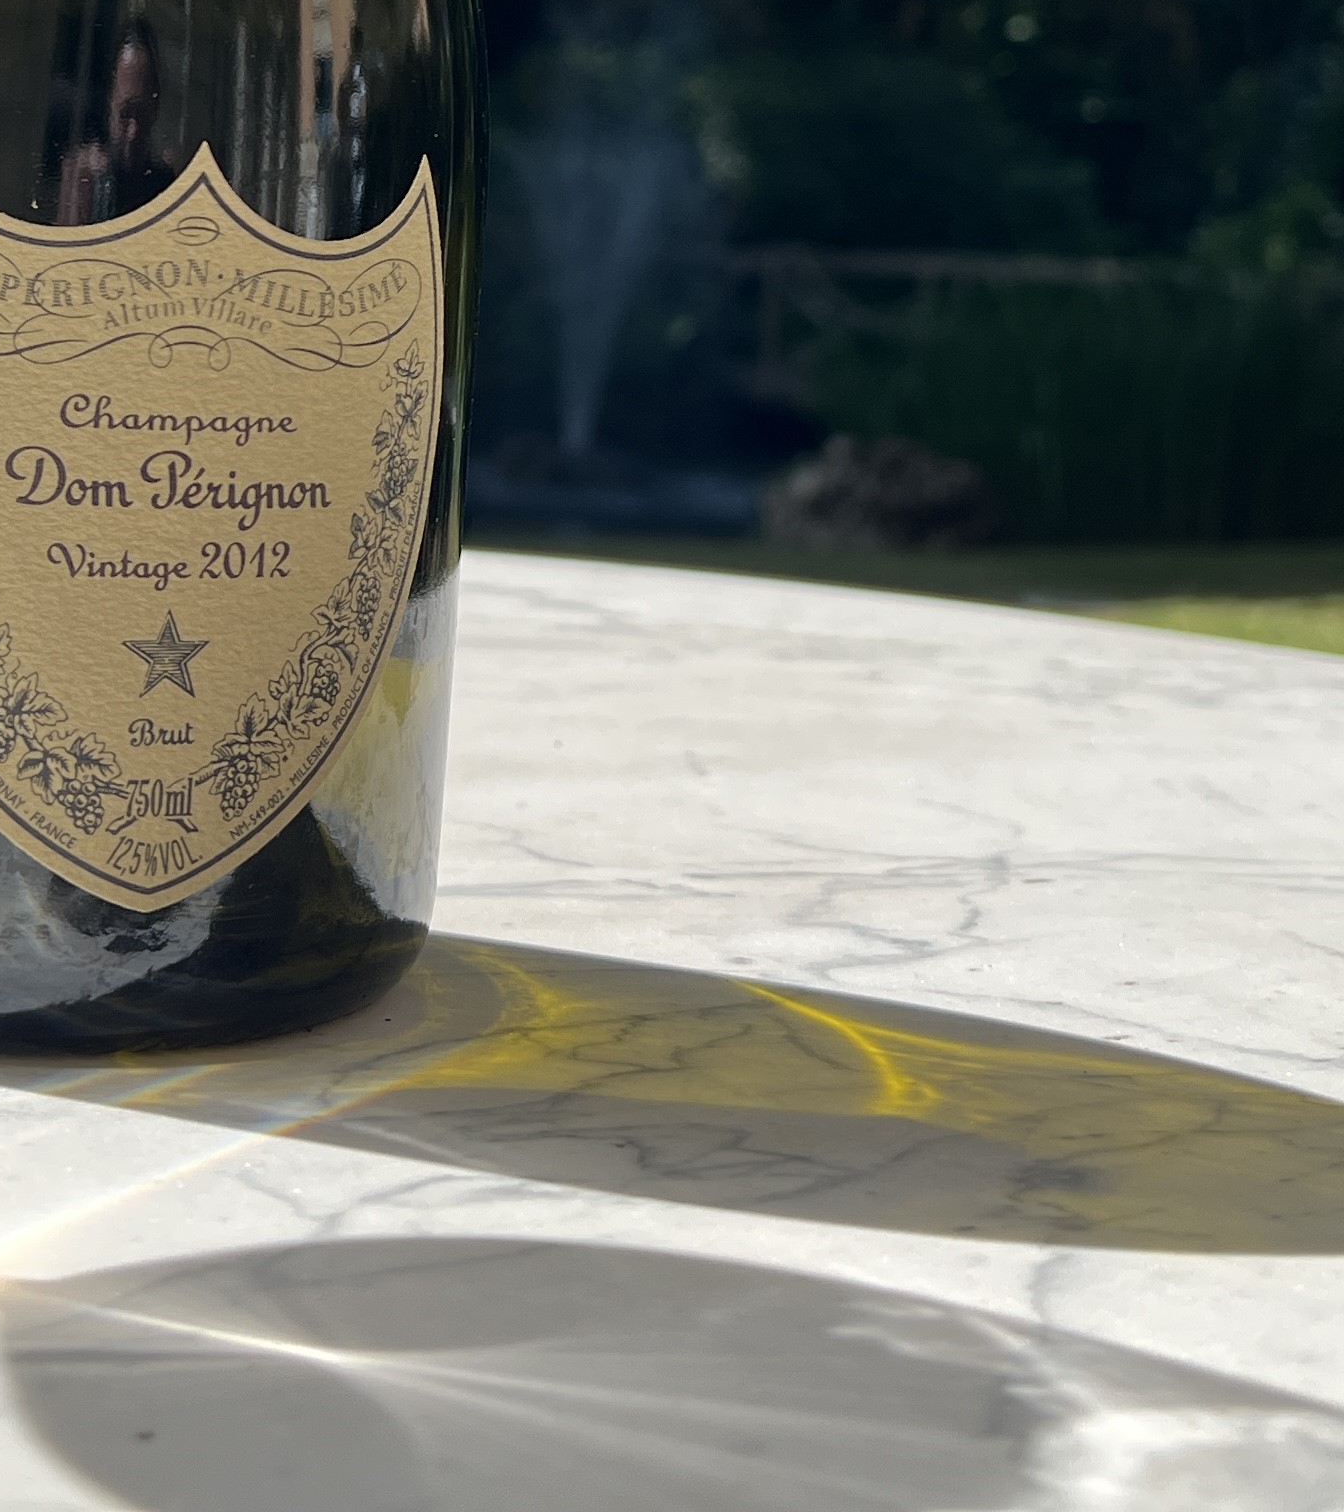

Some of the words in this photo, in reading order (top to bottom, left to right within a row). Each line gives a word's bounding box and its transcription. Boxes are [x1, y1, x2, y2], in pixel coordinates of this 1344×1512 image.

[103, 297, 186, 331] Altum
[191, 296, 273, 335] Villare
[59, 393, 298, 447] Champagne
[5, 445, 134, 508] Dom
[140, 449, 332, 532] Pérignon
[47, 542, 191, 592] Vintage
[199, 541, 291, 580] 2012
[331, 674, 365, 731] PRODUCT
[361, 657, 372, 675] OF
[369, 610, 391, 657] FRANCE
[128, 718, 195, 747] Brut
[126, 776, 193, 818] 750ml
[29, 811, 78, 850] FRANCE
